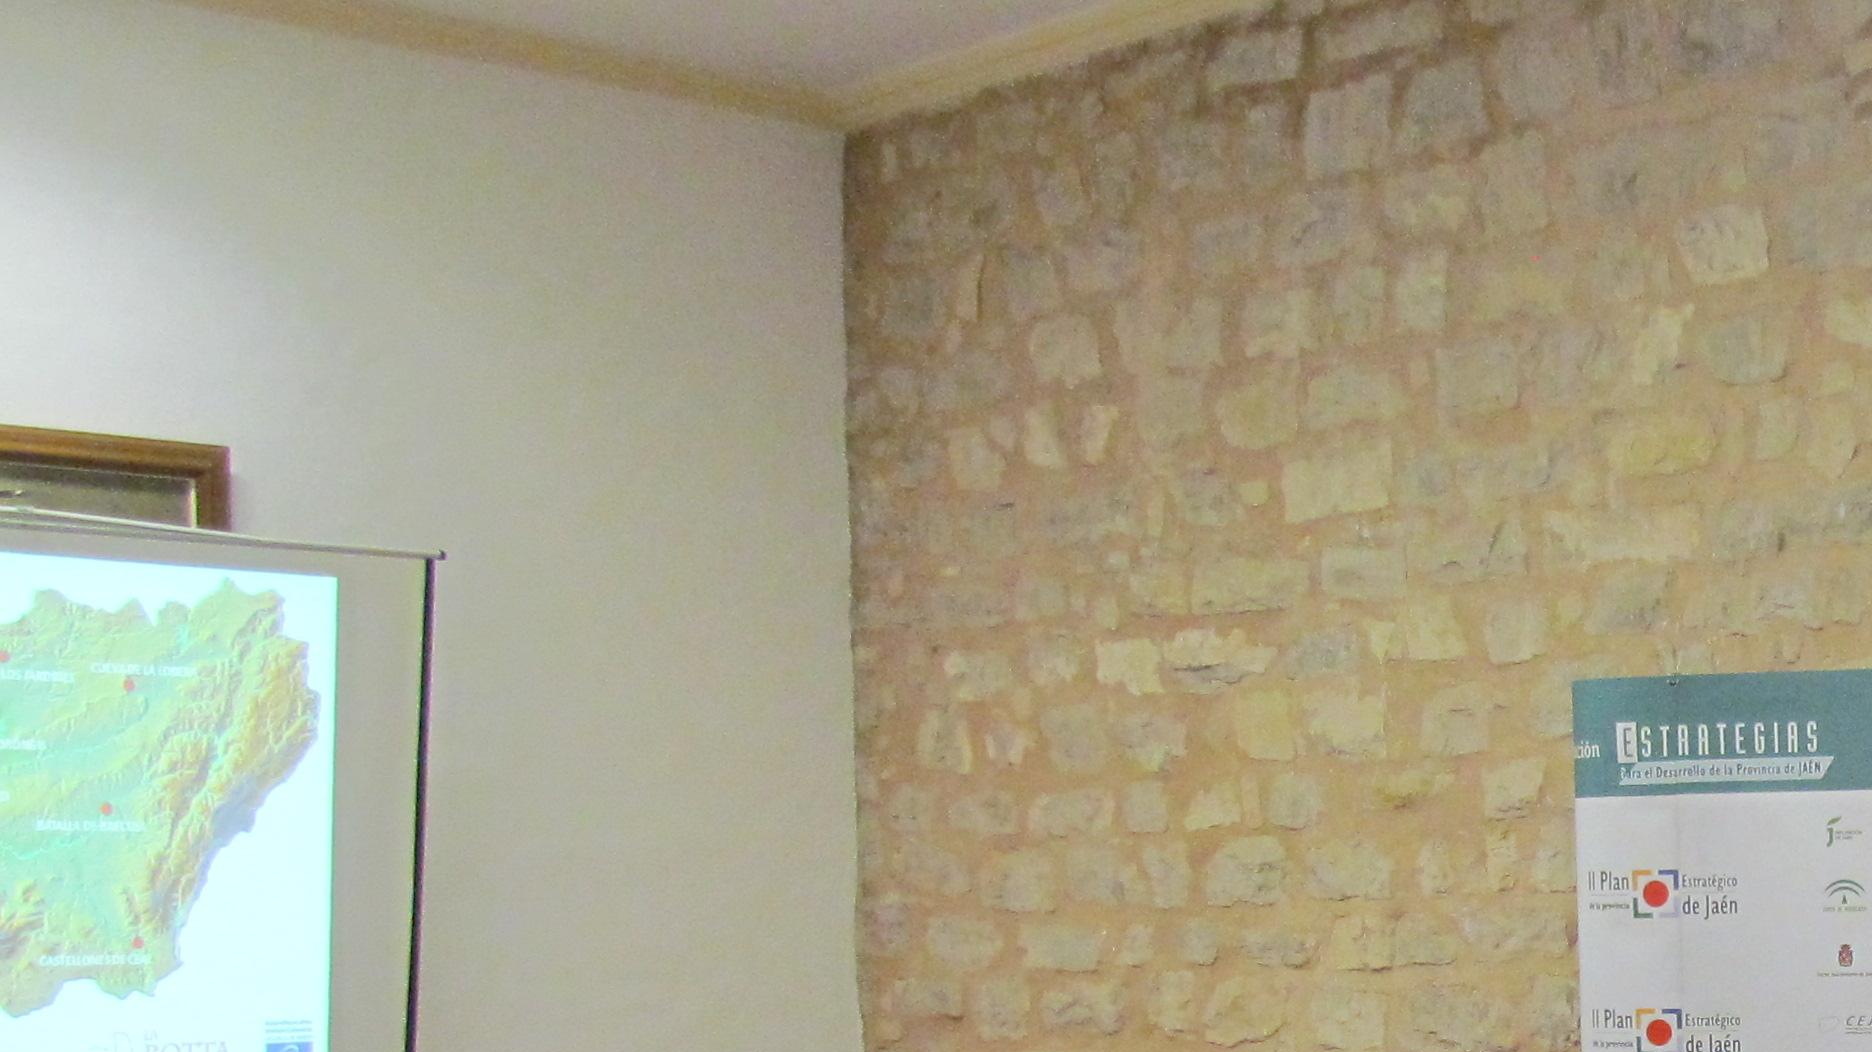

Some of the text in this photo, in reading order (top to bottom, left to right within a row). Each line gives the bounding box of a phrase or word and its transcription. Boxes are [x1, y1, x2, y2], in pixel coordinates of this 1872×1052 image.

[1618, 720, 1818, 761] ESTRATEGIAS
[1644, 767, 1652, 778] el
[1656, 765, 1706, 779] Desarrollo
[1709, 764, 1721, 776] de
[1724, 763, 1732, 776] la
[1737, 763, 1781, 776] Provincia
[1784, 762, 1794, 774] de
[1799, 760, 1821, 777] JAÉN
[1588, 871, 1629, 891] II Plan
[1682, 873, 1738, 891] Estratégico
[1682, 894, 1738, 920] de Jaén
[1592, 1009, 1633, 1029] II Plan
[1685, 1013, 1741, 1030] Estratégico
